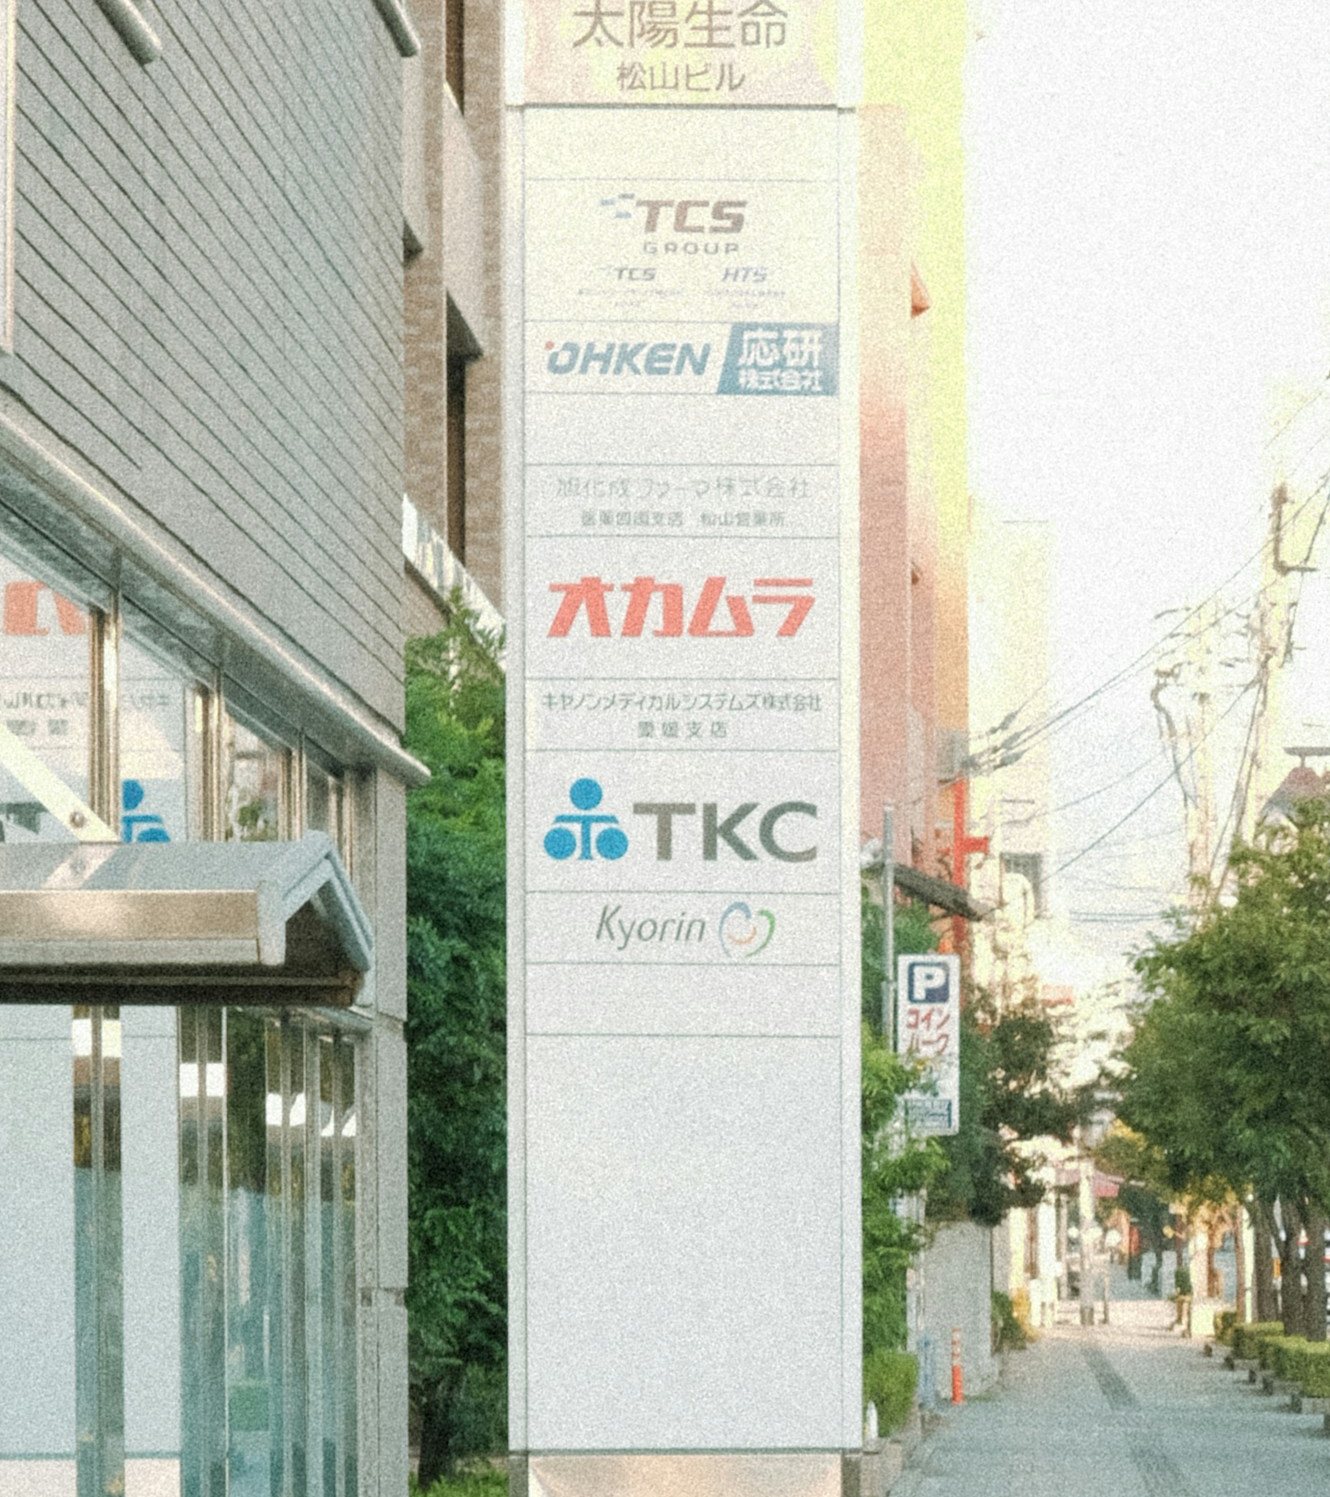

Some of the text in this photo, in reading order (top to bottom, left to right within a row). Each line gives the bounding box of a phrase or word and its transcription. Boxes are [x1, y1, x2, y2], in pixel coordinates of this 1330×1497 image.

[616, 60, 746, 92] 松山ビル
[636, 199, 749, 234] TCS
[642, 241, 739, 255] GROUP
[614, 266, 656, 281] TCS
[721, 267, 768, 282] HTS
[546, 340, 710, 376] OHKEN
[738, 328, 823, 367] 応研
[738, 369, 823, 391] 株式会社
[547, 576, 816, 637] オカムラ
[633, 802, 818, 863] TKC
[596, 905, 706, 951] Kyorin
[913, 967, 945, 1000] P
[907, 1008, 950, 1030] コイン
